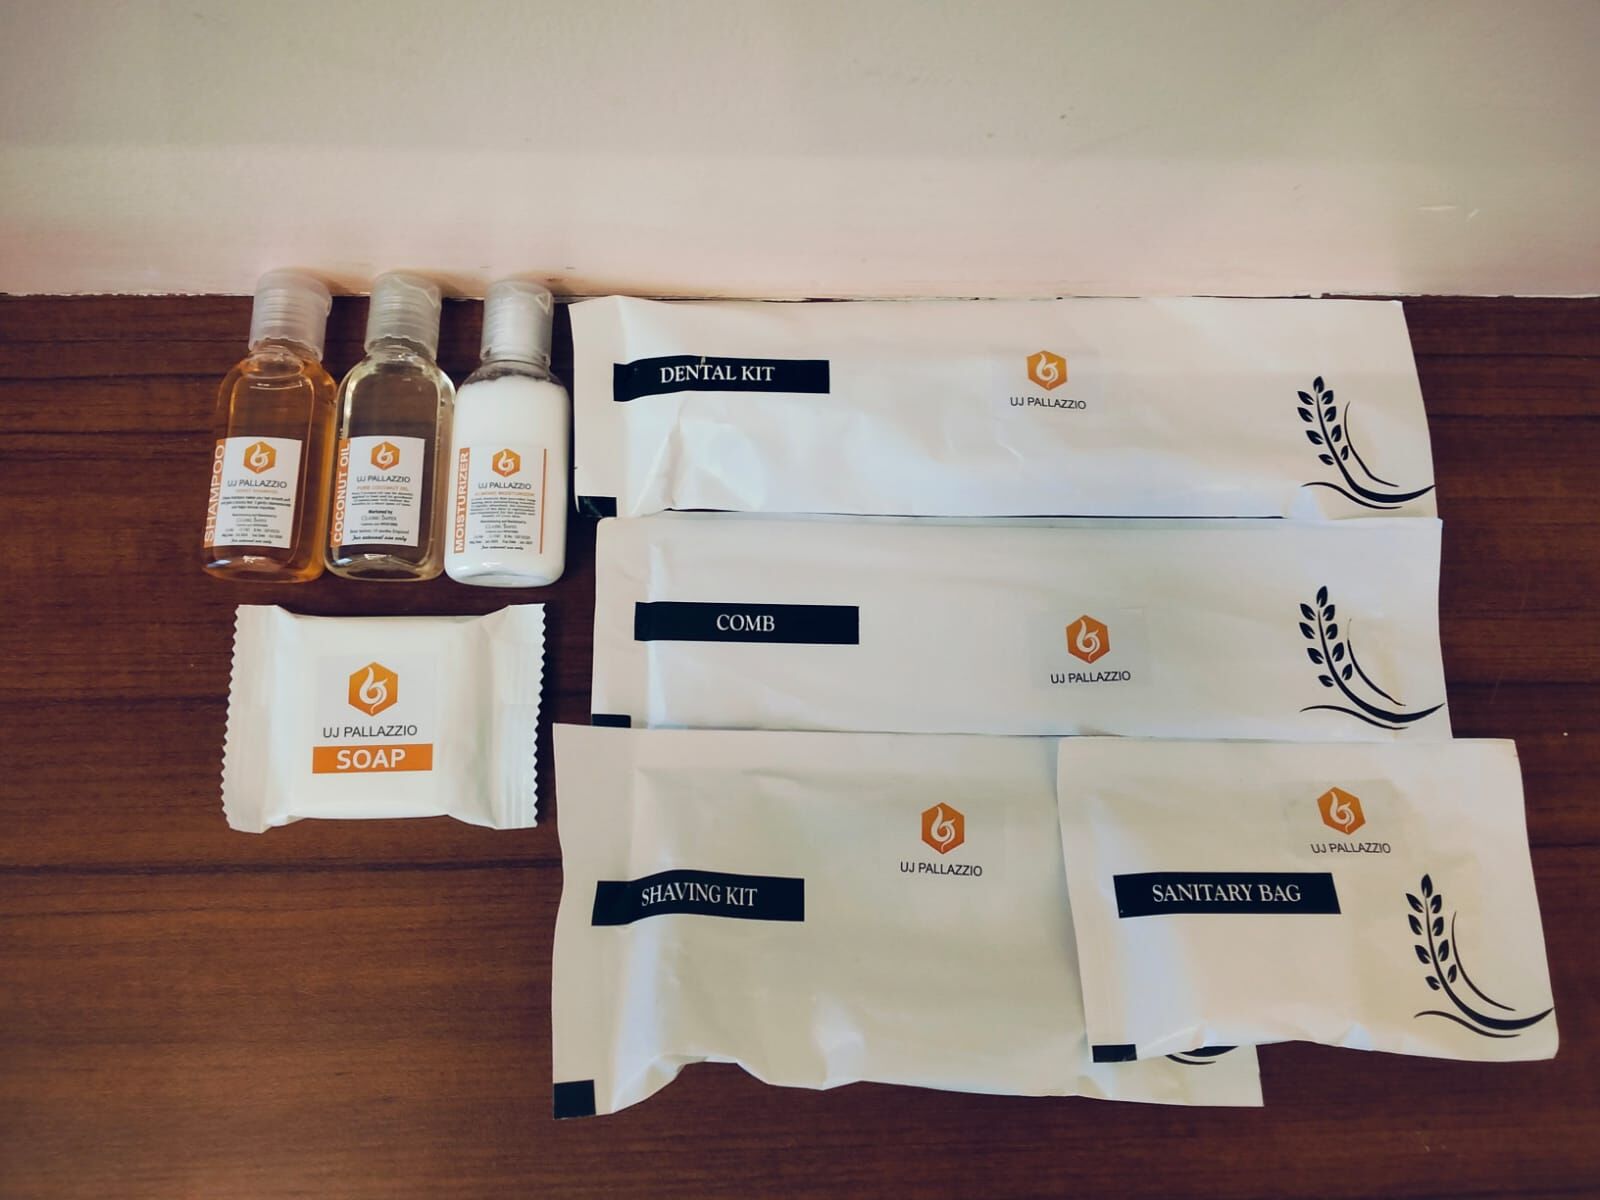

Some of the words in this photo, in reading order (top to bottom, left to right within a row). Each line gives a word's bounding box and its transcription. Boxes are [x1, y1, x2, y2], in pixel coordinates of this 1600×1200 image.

[660, 364, 737, 384] DENTAL
[741, 366, 775, 382] KIT
[1010, 397, 1024, 407] UJ
[1027, 397, 1087, 410] PALLAZZIO
[340, 442, 350, 466] OIL
[227, 479, 237, 488] UJ
[238, 479, 288, 489] PALLAZZIO
[356, 475, 366, 483] UJ
[367, 475, 411, 483] PALLAZZIO
[489, 482, 532, 490] PALLAZZIO
[204, 445, 225, 542] SHAMPOO
[455, 452, 469, 551] MOISTURIZER
[333, 471, 348, 542] COCONUT
[716, 613, 775, 632] COMB
[1050, 673, 1065, 684] UJ
[1068, 670, 1131, 683] PALLAZZIO
[323, 727, 339, 738] UJ
[344, 725, 418, 738] PALLAZZIO
[336, 748, 406, 770] SOAP
[1310, 843, 1327, 854] UJ
[1329, 842, 1392, 854] PALLAZZIO
[900, 861, 915, 873] UJ
[918, 862, 983, 877] PALLAZZIO
[641, 882, 721, 907] SHAVING
[726, 886, 758, 907] KIT
[1152, 884, 1252, 902] SANITARY
[1258, 884, 1301, 902] BAG
